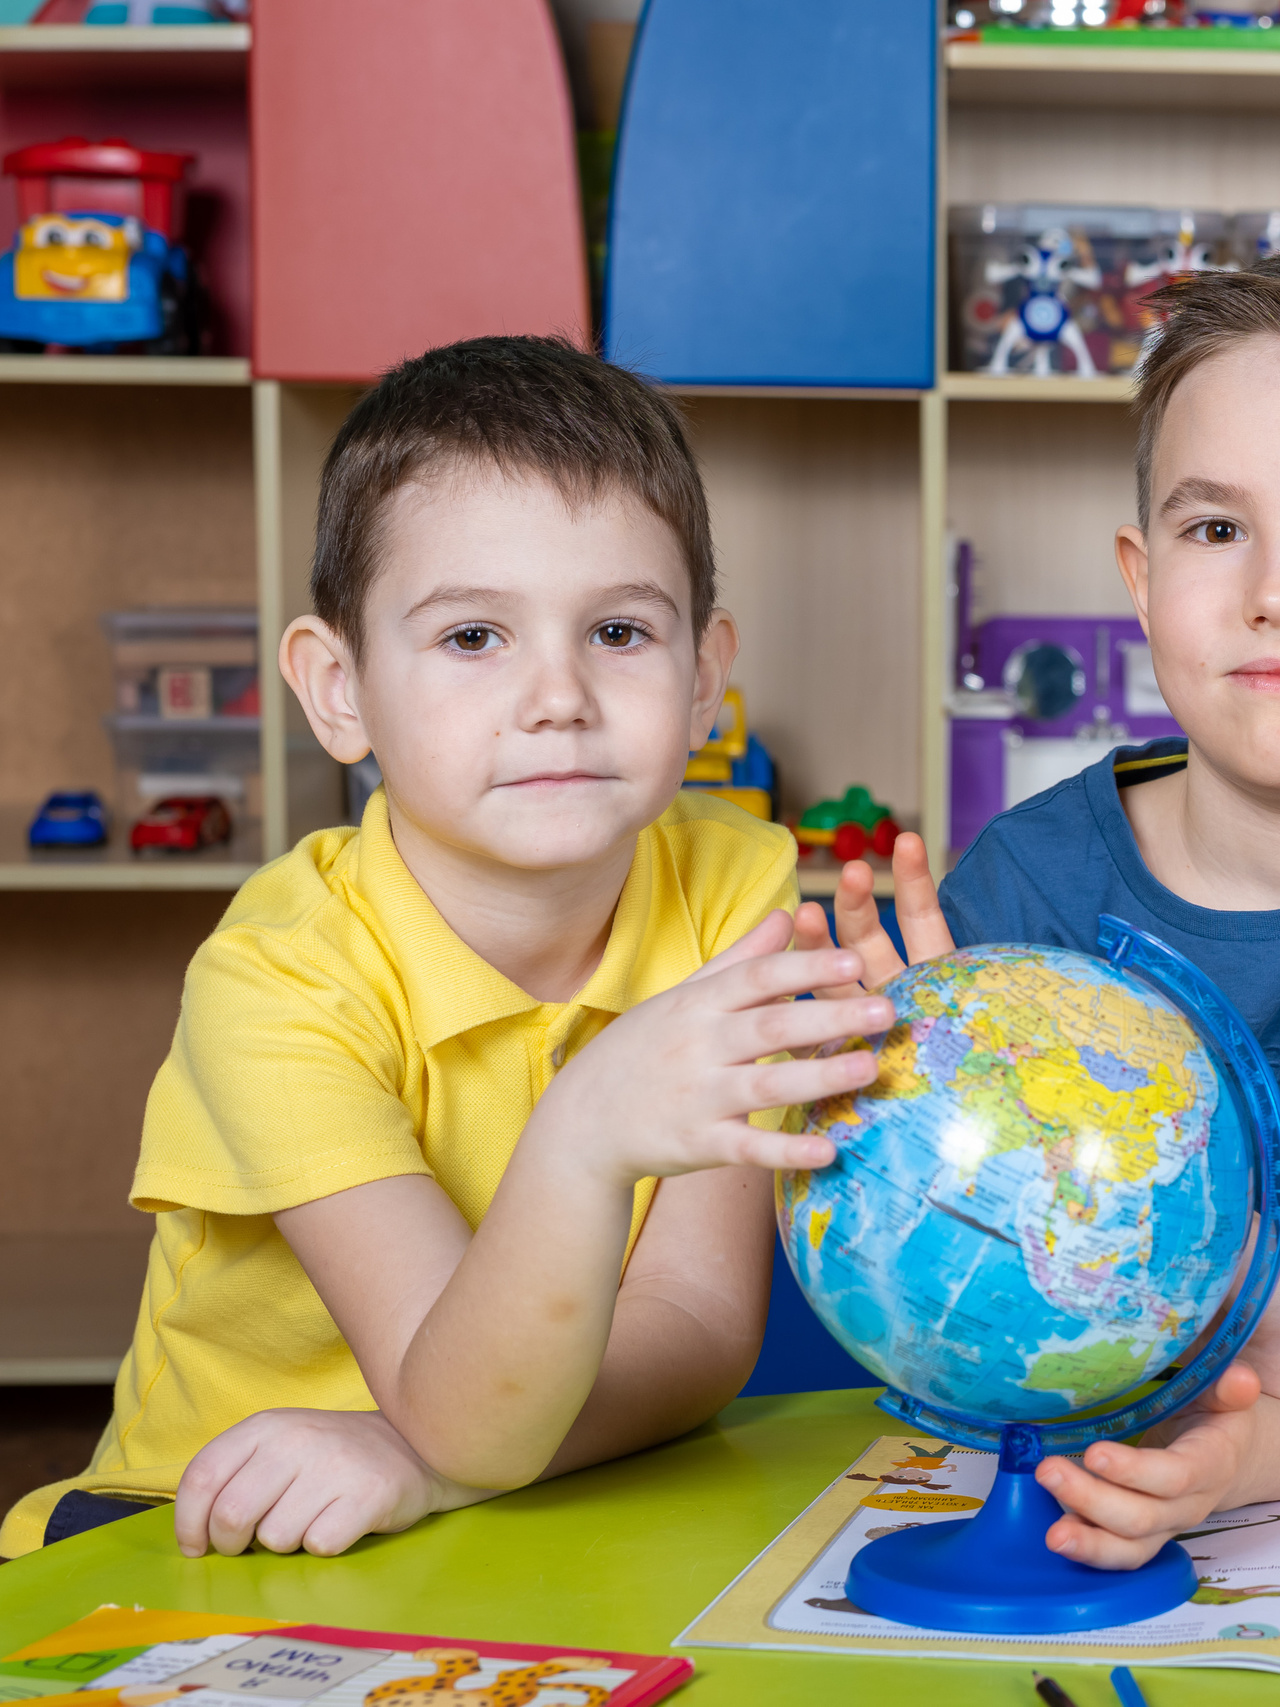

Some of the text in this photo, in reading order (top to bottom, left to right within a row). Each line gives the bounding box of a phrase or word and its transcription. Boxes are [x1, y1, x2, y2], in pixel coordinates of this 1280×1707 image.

[271, 1647, 344, 1668] САМ
[225, 1658, 331, 1684] ЧИТАЮ
[239, 1677, 270, 1690] Я
